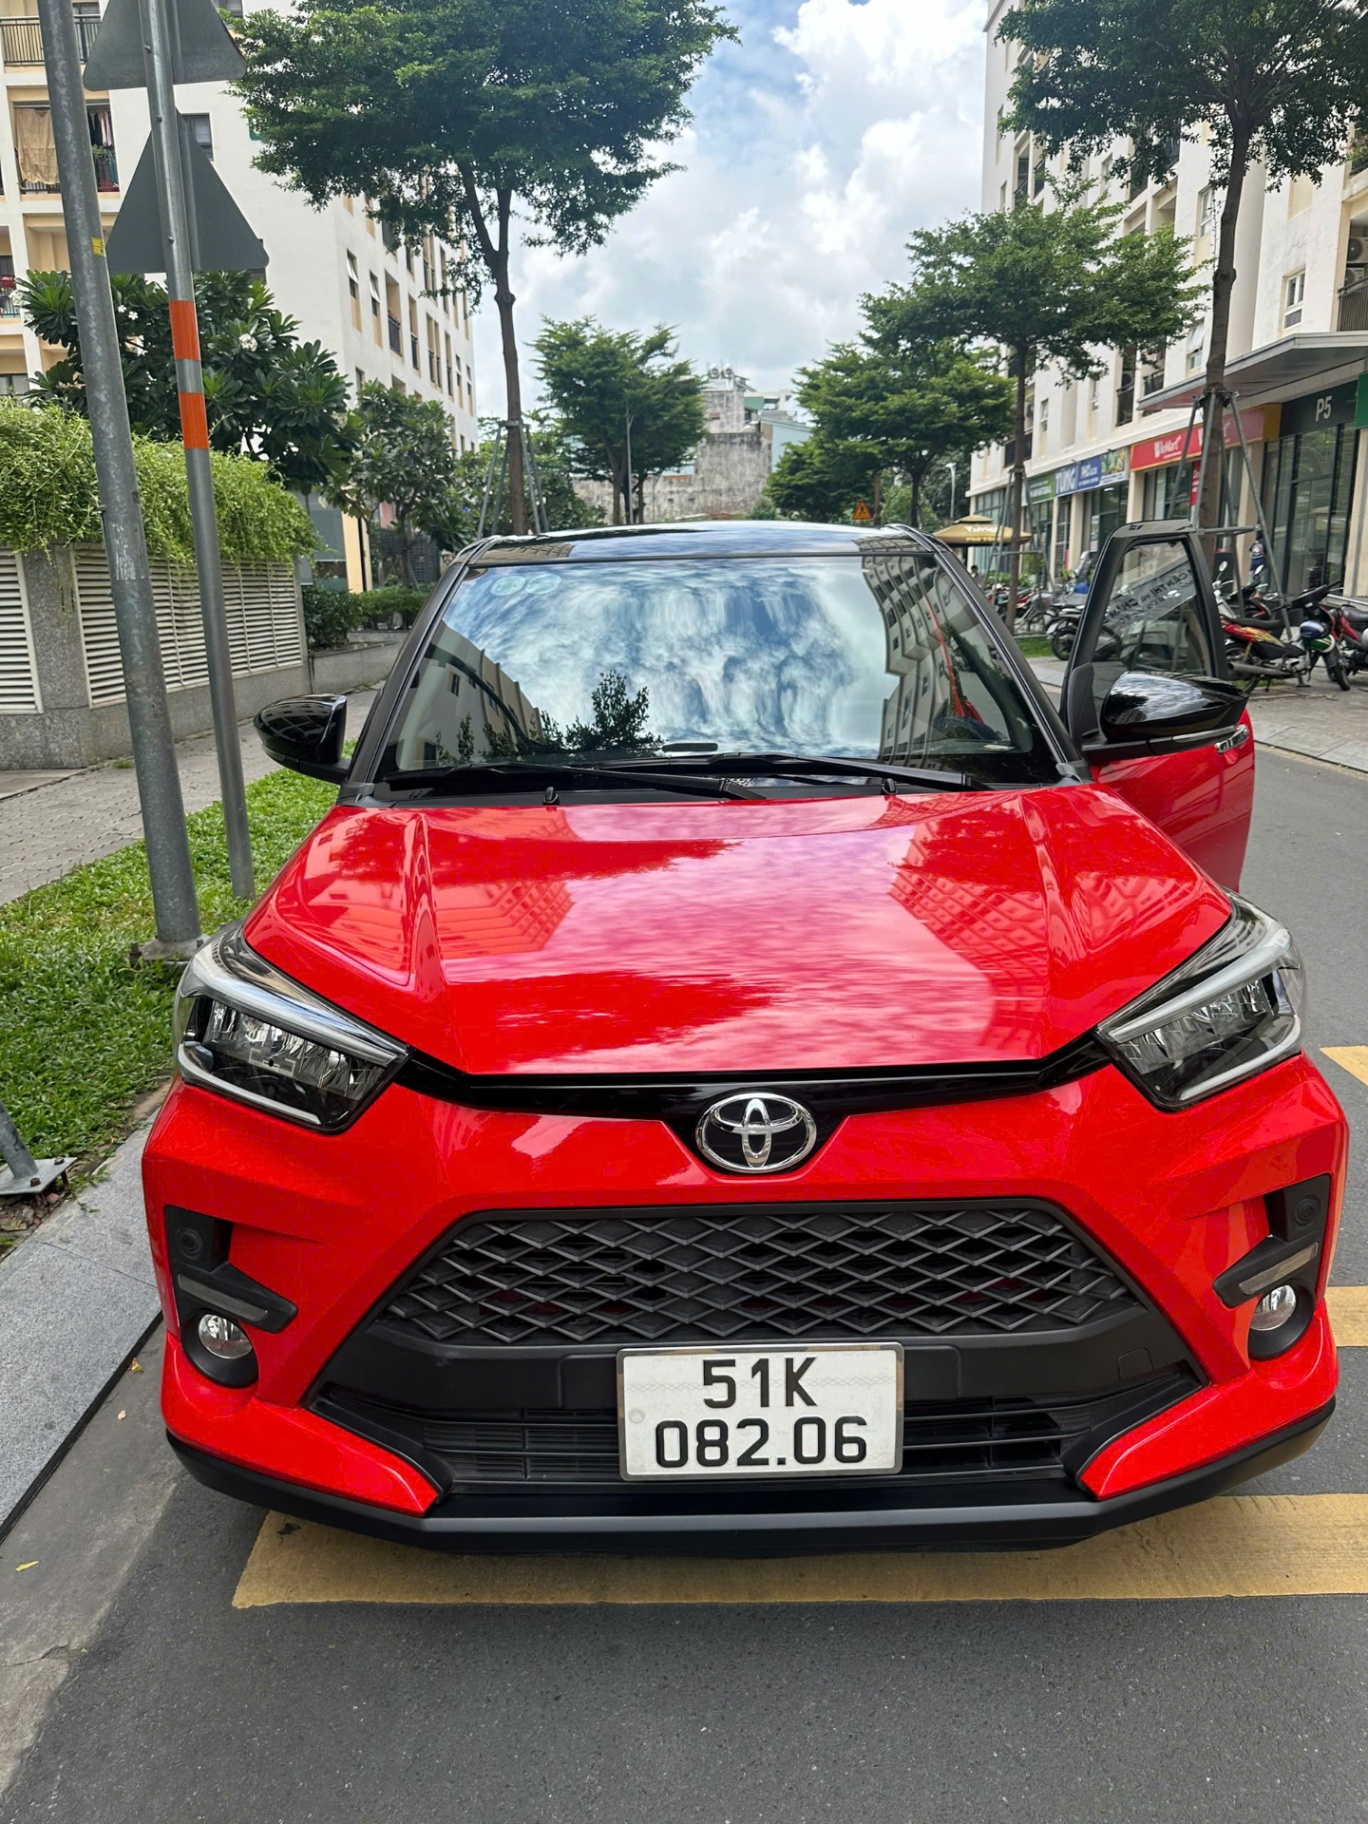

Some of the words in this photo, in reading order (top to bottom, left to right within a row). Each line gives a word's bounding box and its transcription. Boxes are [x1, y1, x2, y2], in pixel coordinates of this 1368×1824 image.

[1315, 395, 1333, 422] P5
[703, 1357, 818, 1409] 51K
[655, 1415, 867, 1468] 082.06
